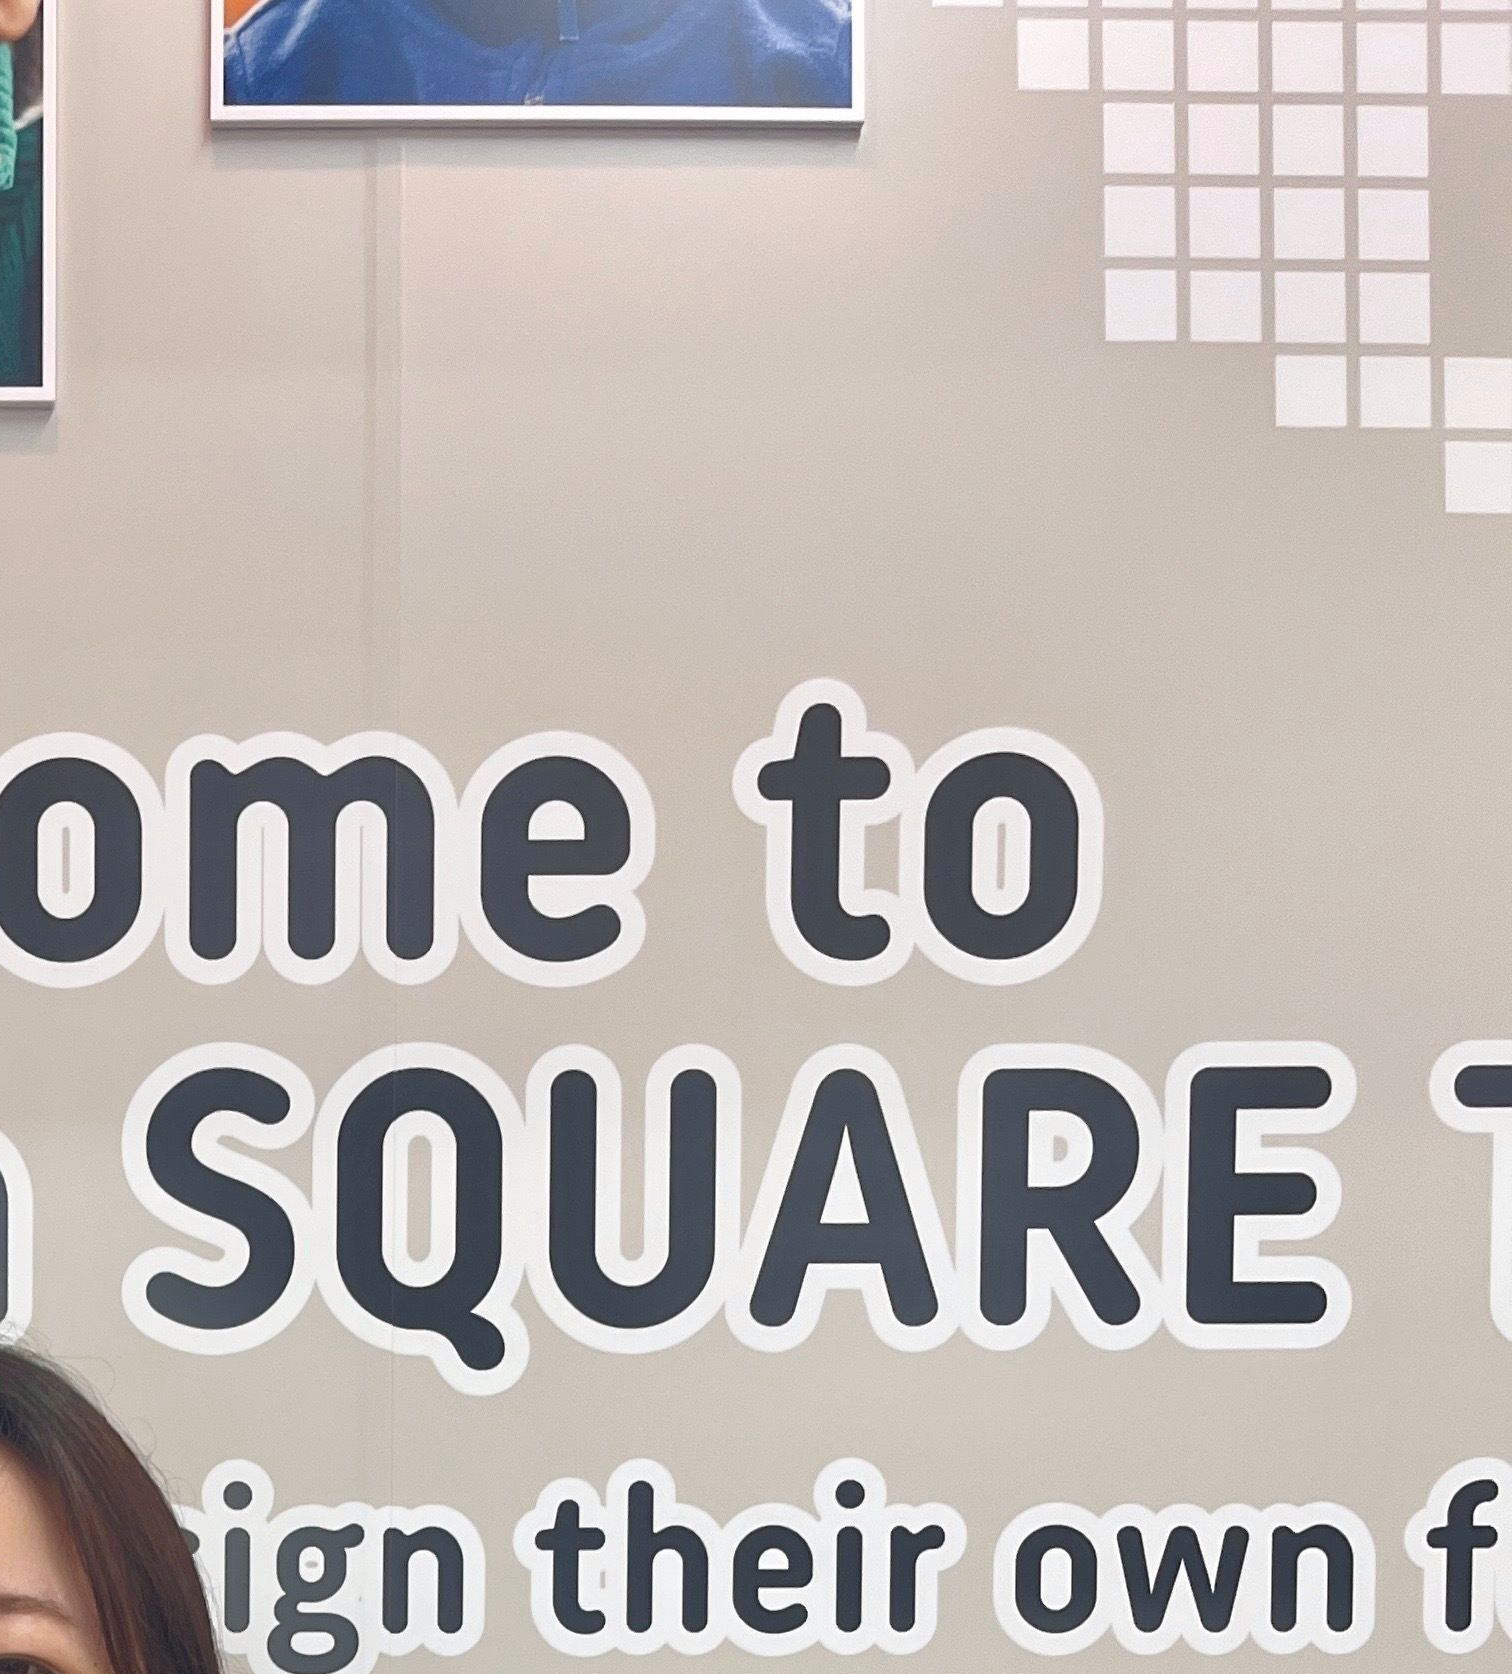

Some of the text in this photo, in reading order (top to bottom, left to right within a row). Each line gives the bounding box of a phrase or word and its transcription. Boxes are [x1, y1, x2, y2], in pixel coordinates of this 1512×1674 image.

[758, 703, 1078, 960] to
[147, 1067, 1331, 1370] SQUARE
[181, 1482, 463, 1674] ign
[535, 1480, 945, 1634] their
[1016, 1525, 1353, 1633] own
